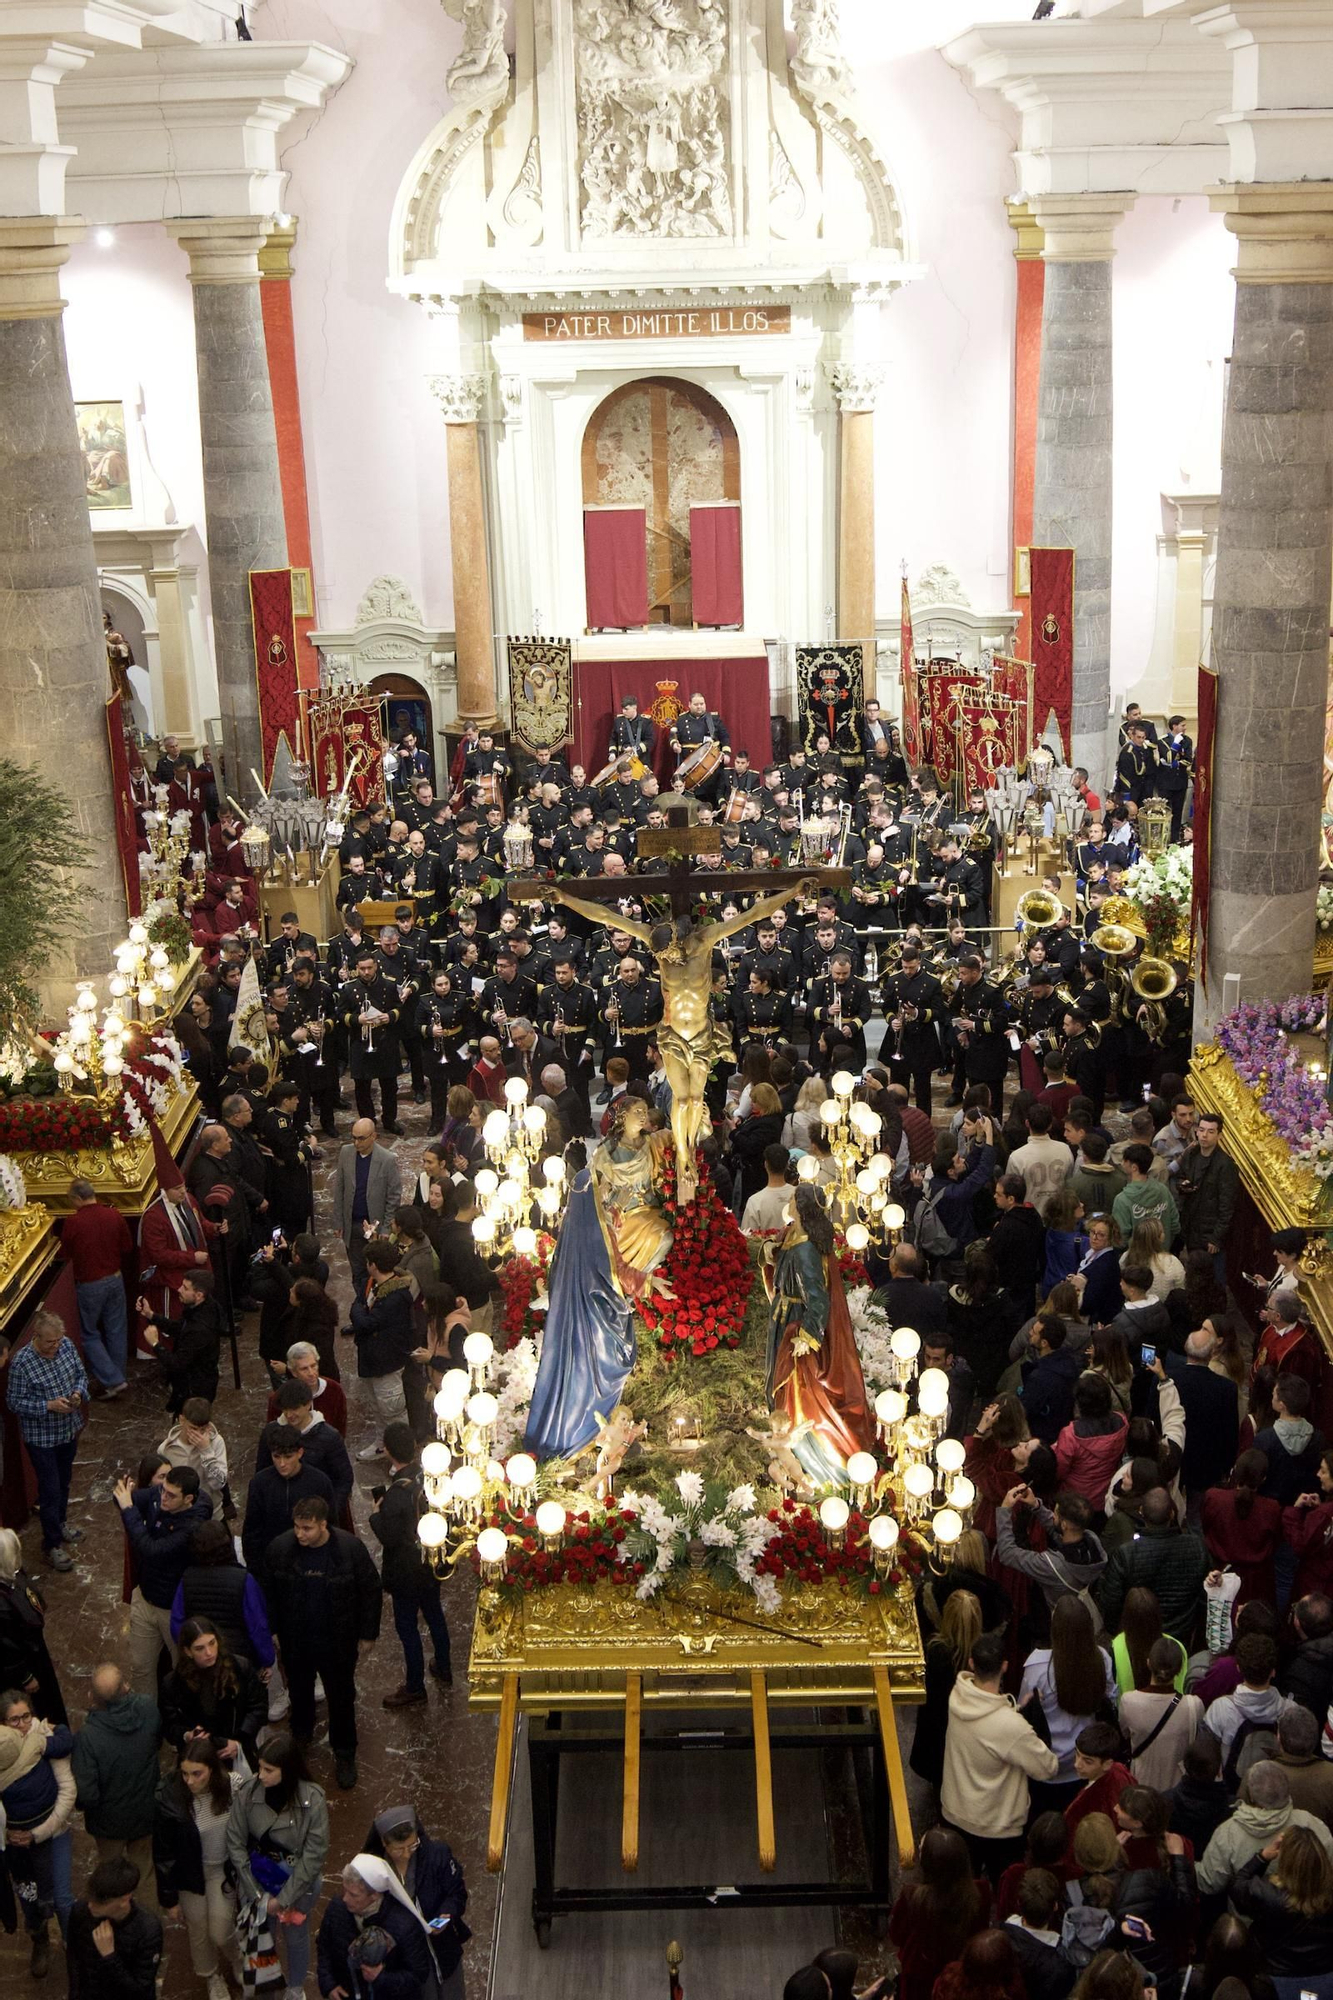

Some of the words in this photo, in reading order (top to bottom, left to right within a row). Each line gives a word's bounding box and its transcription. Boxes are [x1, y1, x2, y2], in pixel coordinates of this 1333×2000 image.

[544, 316, 612, 337] PATER
[623, 313, 701, 335] DIMITTE
[710, 311, 769, 332] ILLOS
